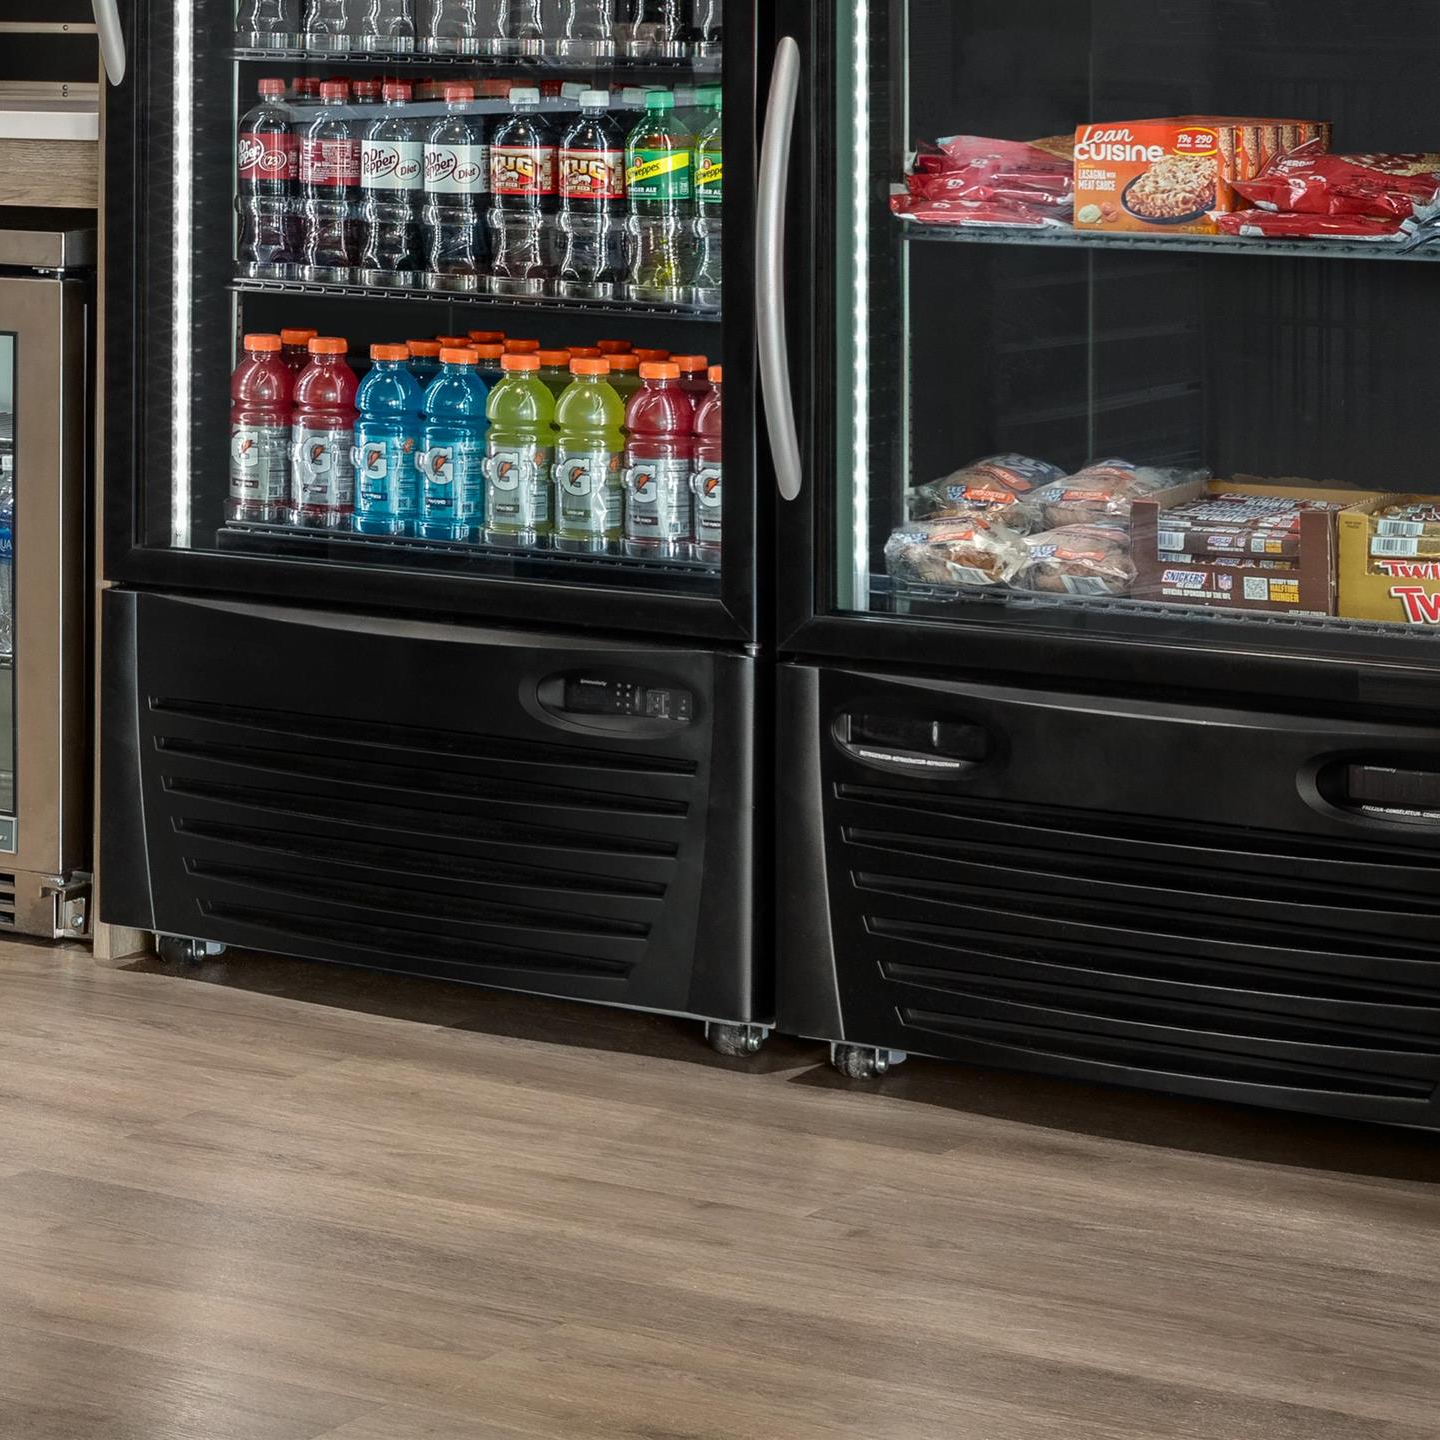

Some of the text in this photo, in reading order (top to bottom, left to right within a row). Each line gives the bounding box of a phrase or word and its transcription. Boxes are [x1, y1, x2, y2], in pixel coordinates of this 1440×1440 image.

[1082, 127, 1133, 144] Lean
[1195, 135, 1212, 143] 290
[268, 155, 279, 166] 23
[371, 148, 384, 159] Dr
[362, 153, 396, 177] Pepper
[401, 165, 417, 174] Diet
[459, 168, 476, 179] Diet
[362, 442, 387, 479] G
[424, 447, 453, 485] G
[490, 452, 519, 491] G
[631, 464, 657, 503] G
[1163, 572, 1205, 584] SNICKERS
